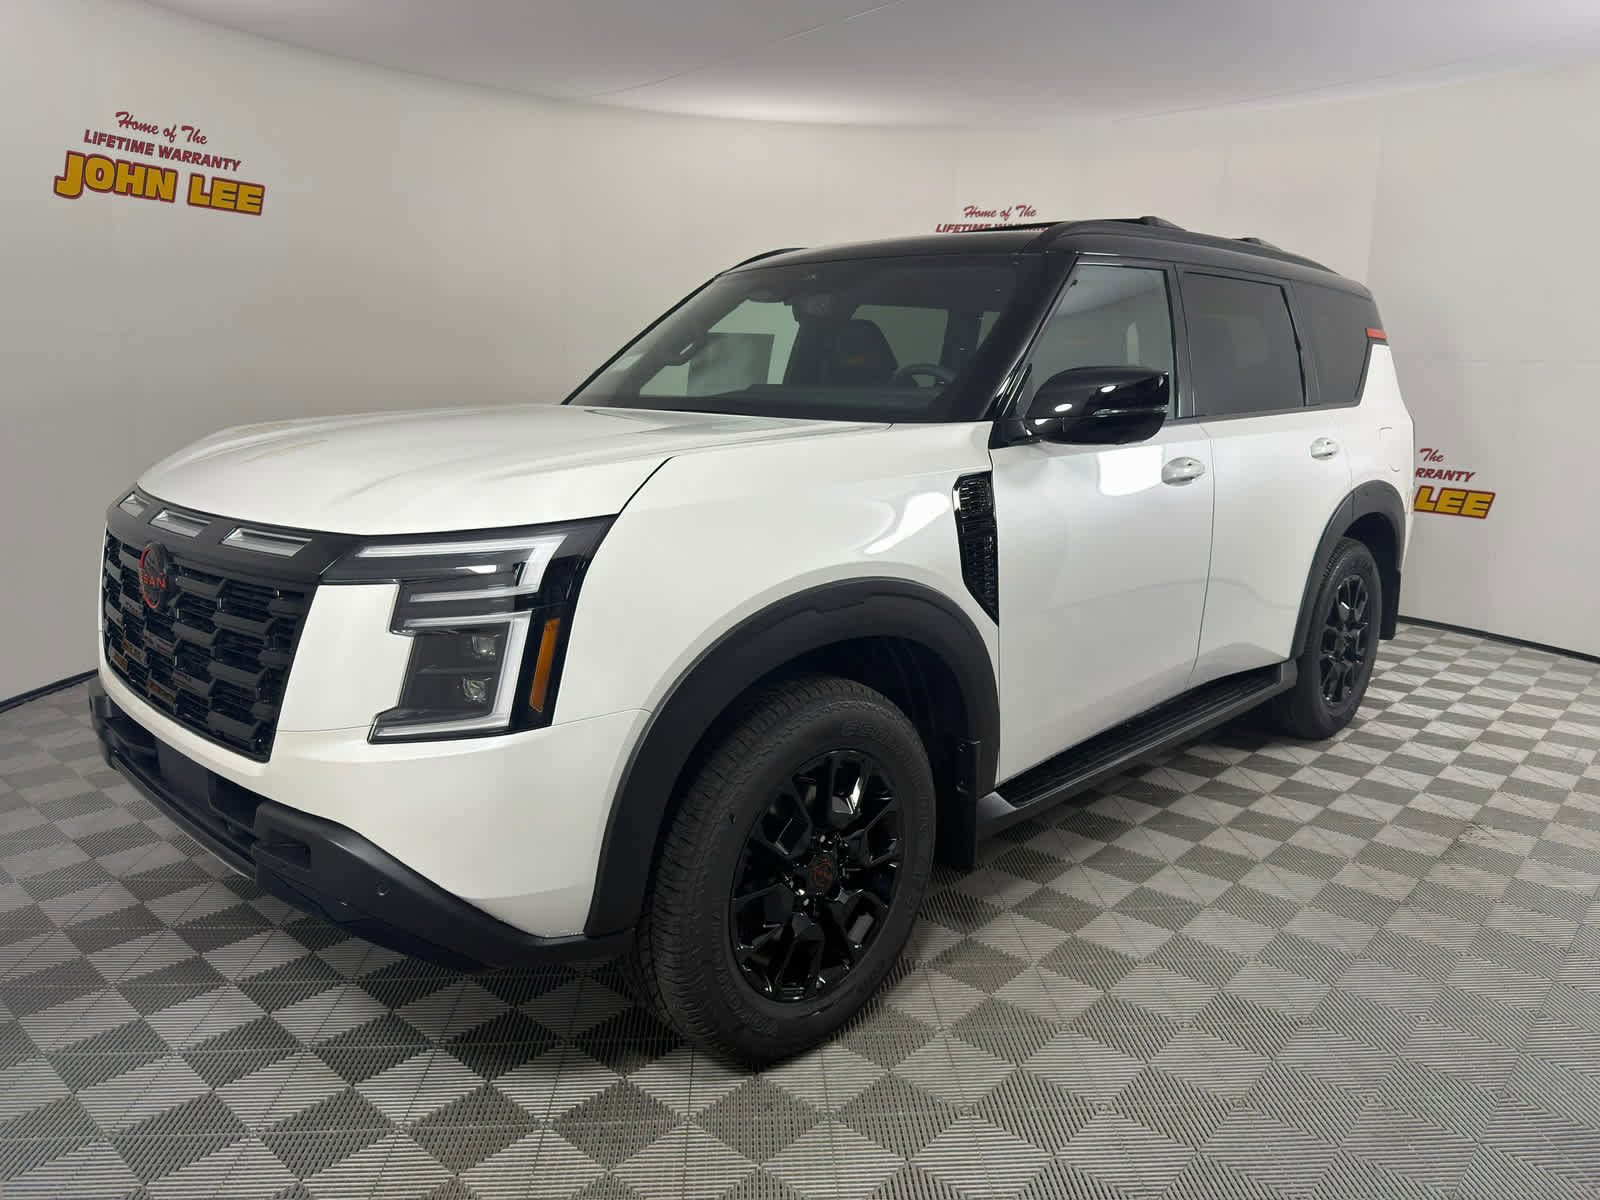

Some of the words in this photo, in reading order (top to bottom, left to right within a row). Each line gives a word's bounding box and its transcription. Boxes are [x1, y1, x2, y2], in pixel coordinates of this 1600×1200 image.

[115, 111, 159, 135] Home
[163, 125, 176, 142] of
[181, 126, 207, 145] The
[83, 129, 155, 157] LIFETIME
[158, 144, 241, 172] WARRANTY
[54, 150, 178, 203] JOHN
[187, 173, 265, 216] LEE
[963, 205, 997, 218] Home
[1000, 206, 1012, 221] of
[1015, 204, 1037, 217] The
[1419, 447, 1444, 463] The
[1415, 467, 1476, 482] RRANTY
[1413, 485, 1496, 519] LEE
